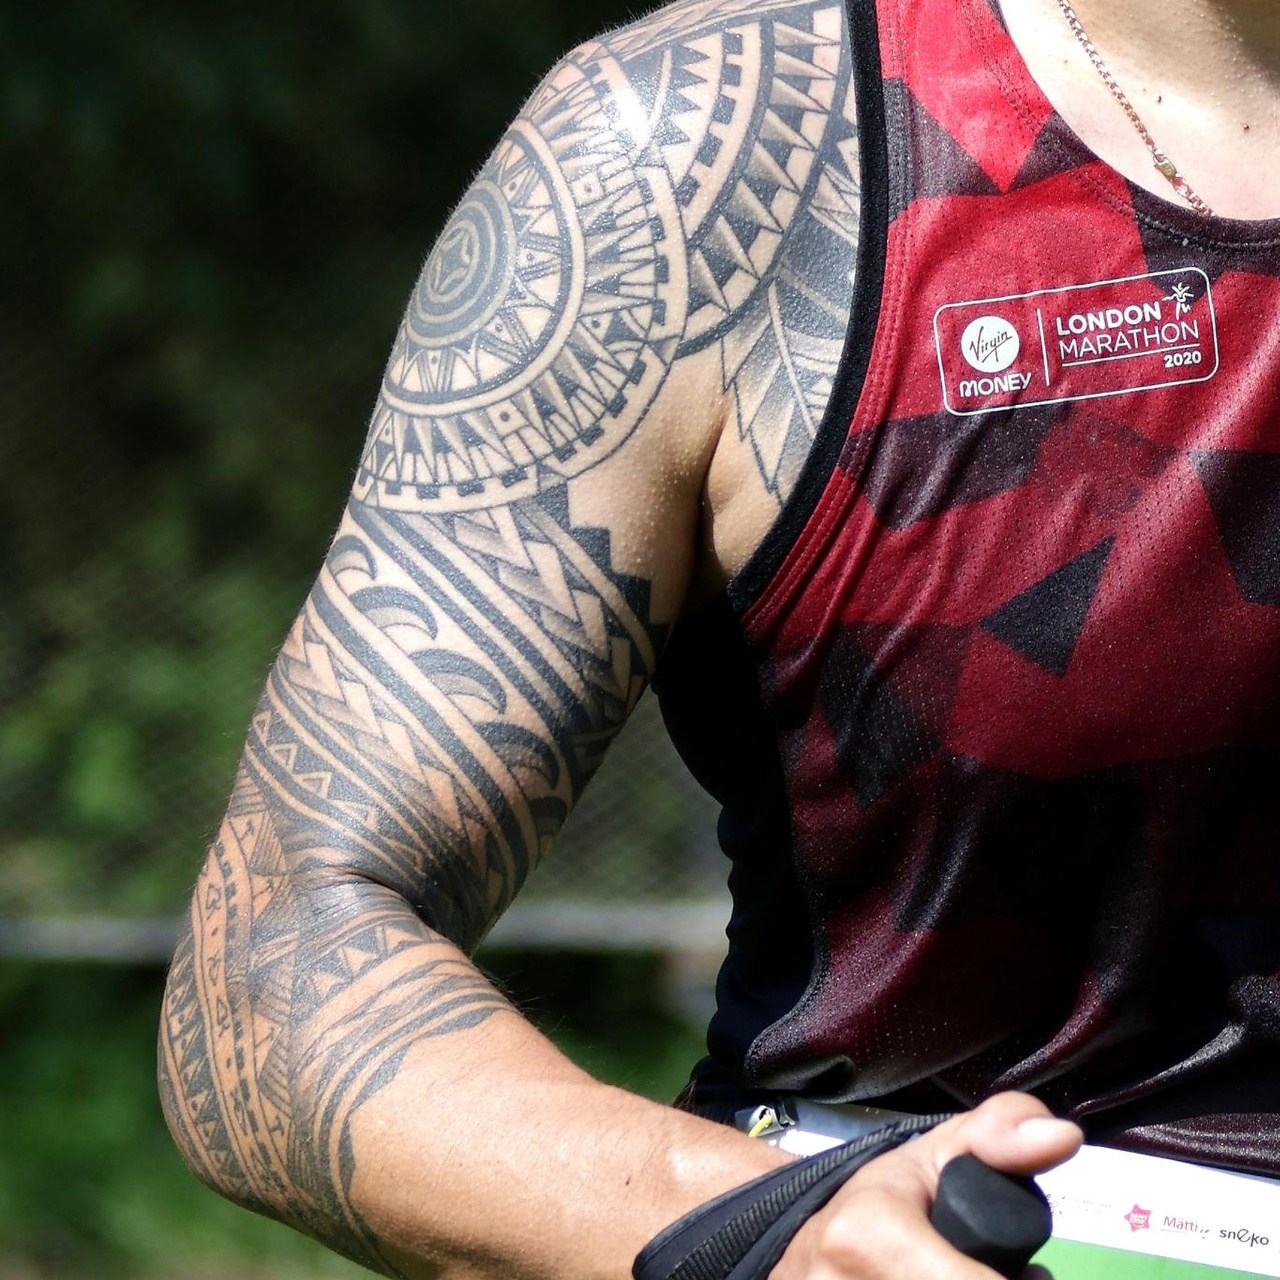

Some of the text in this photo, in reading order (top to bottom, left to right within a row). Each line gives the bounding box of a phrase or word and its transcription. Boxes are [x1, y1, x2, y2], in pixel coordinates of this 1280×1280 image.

[1056, 301, 1162, 336] LONDON
[969, 326, 1013, 363] Virgin
[1059, 319, 1199, 360] MARATHON
[1164, 350, 1202, 369] 2020
[1219, 1228, 1270, 1248] sneko
